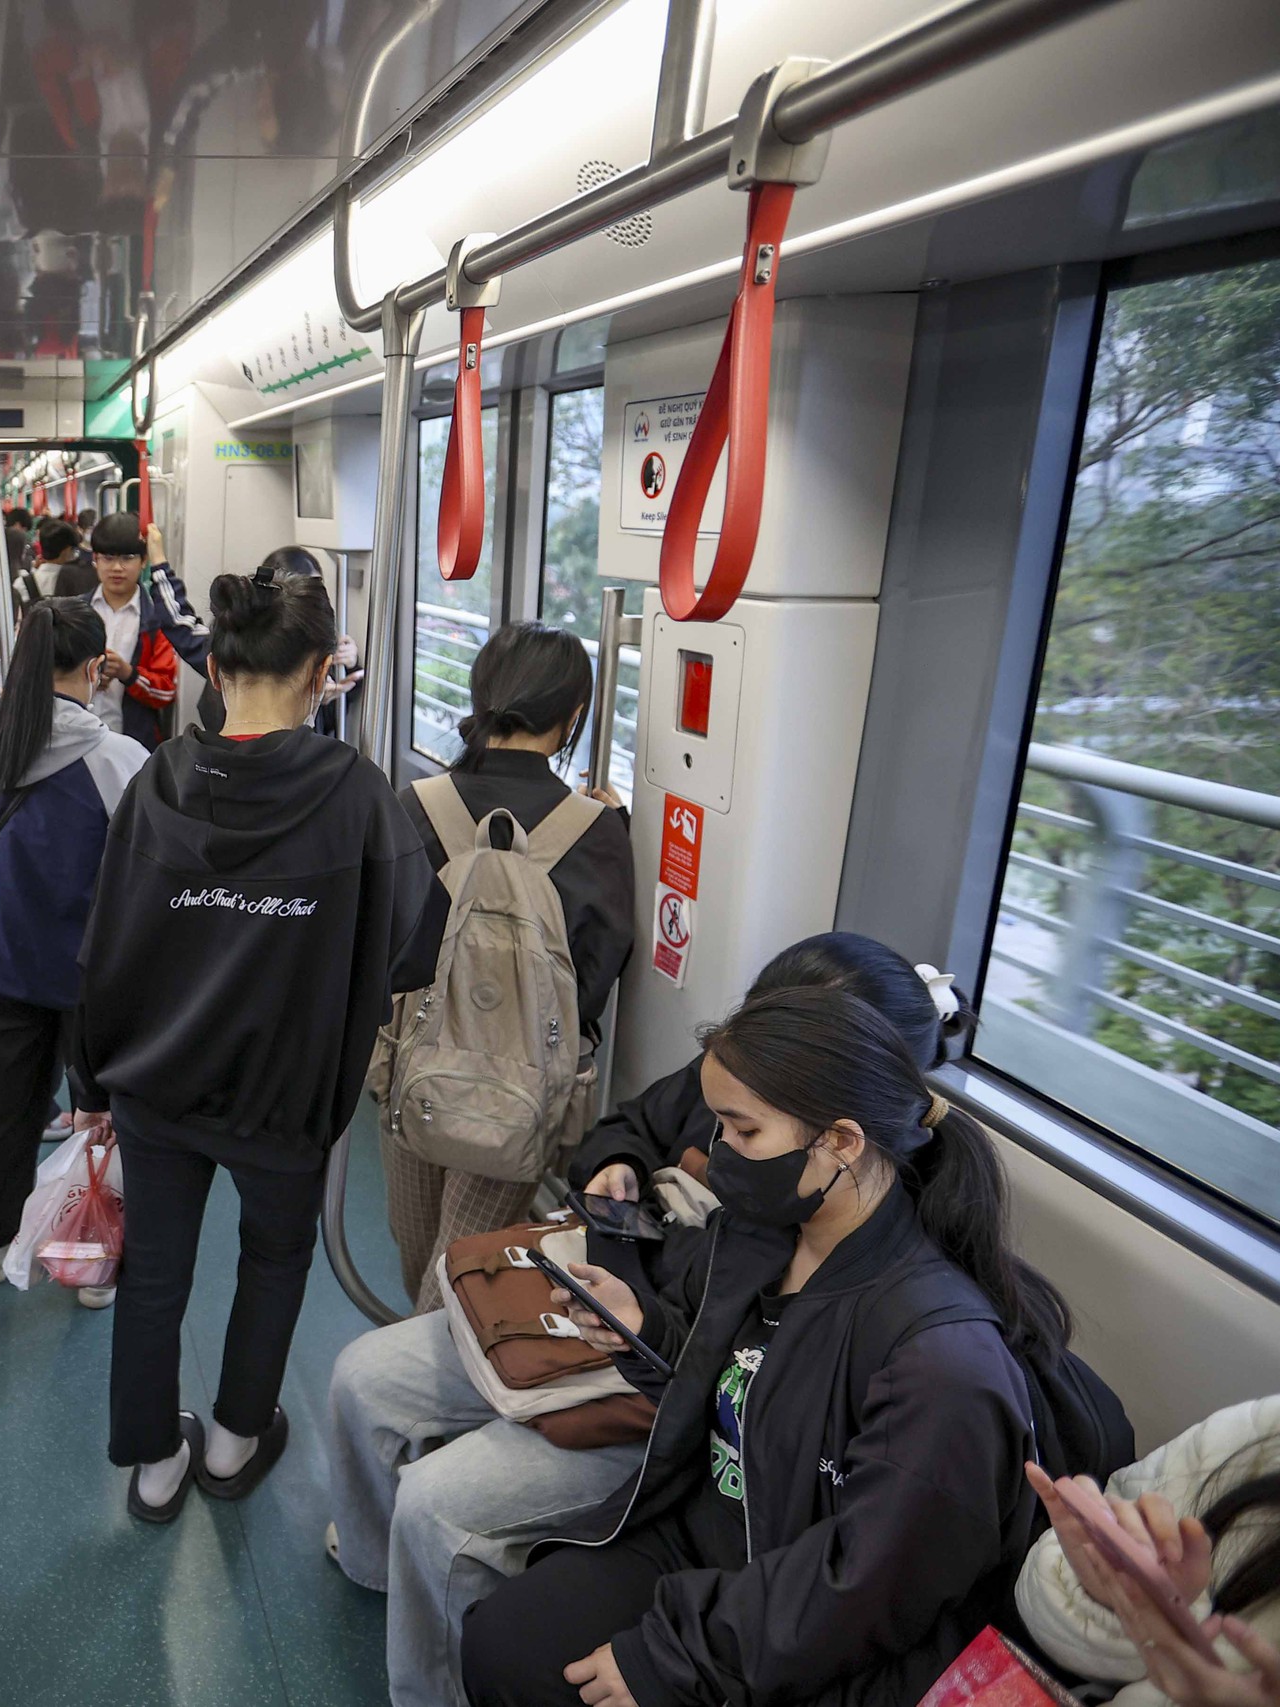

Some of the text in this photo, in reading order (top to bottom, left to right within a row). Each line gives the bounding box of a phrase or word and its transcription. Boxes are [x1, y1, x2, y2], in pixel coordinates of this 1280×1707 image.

[641, 511, 668, 523] Keep Sile
[170, 887, 318, 917] And That's All That
